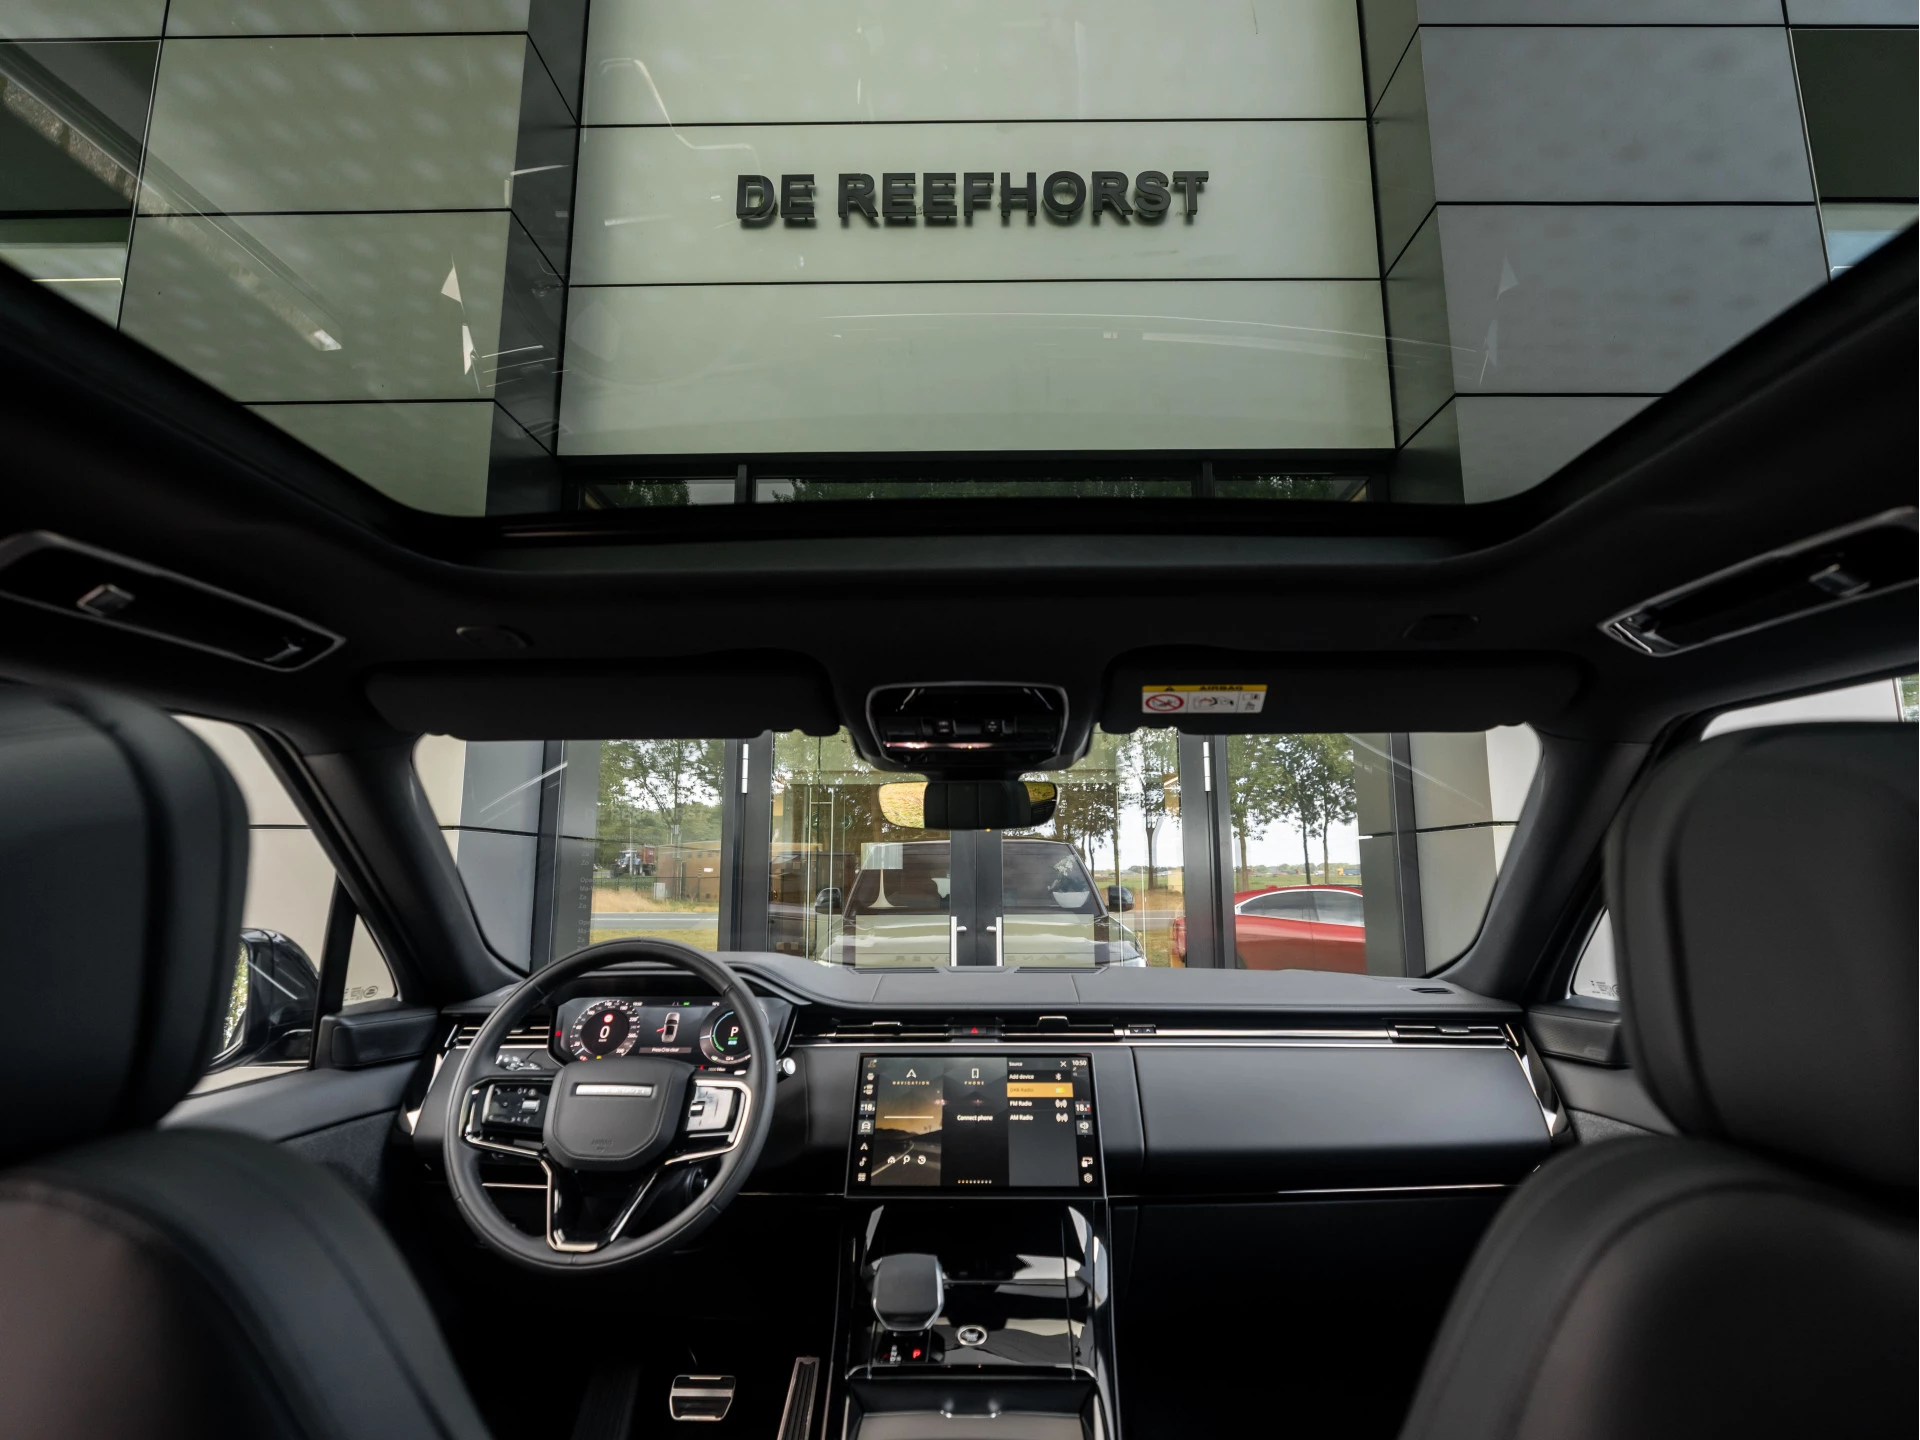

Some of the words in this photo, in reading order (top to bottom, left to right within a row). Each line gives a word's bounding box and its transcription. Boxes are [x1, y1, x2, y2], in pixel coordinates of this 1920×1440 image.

[735, 173, 816, 219] DE
[837, 171, 1209, 219] REEFHORST
[600, 1025, 610, 1039] 0
[730, 1026, 739, 1037] P
[978, 1114, 993, 1122] phone
[912, 1348, 921, 1359] P
